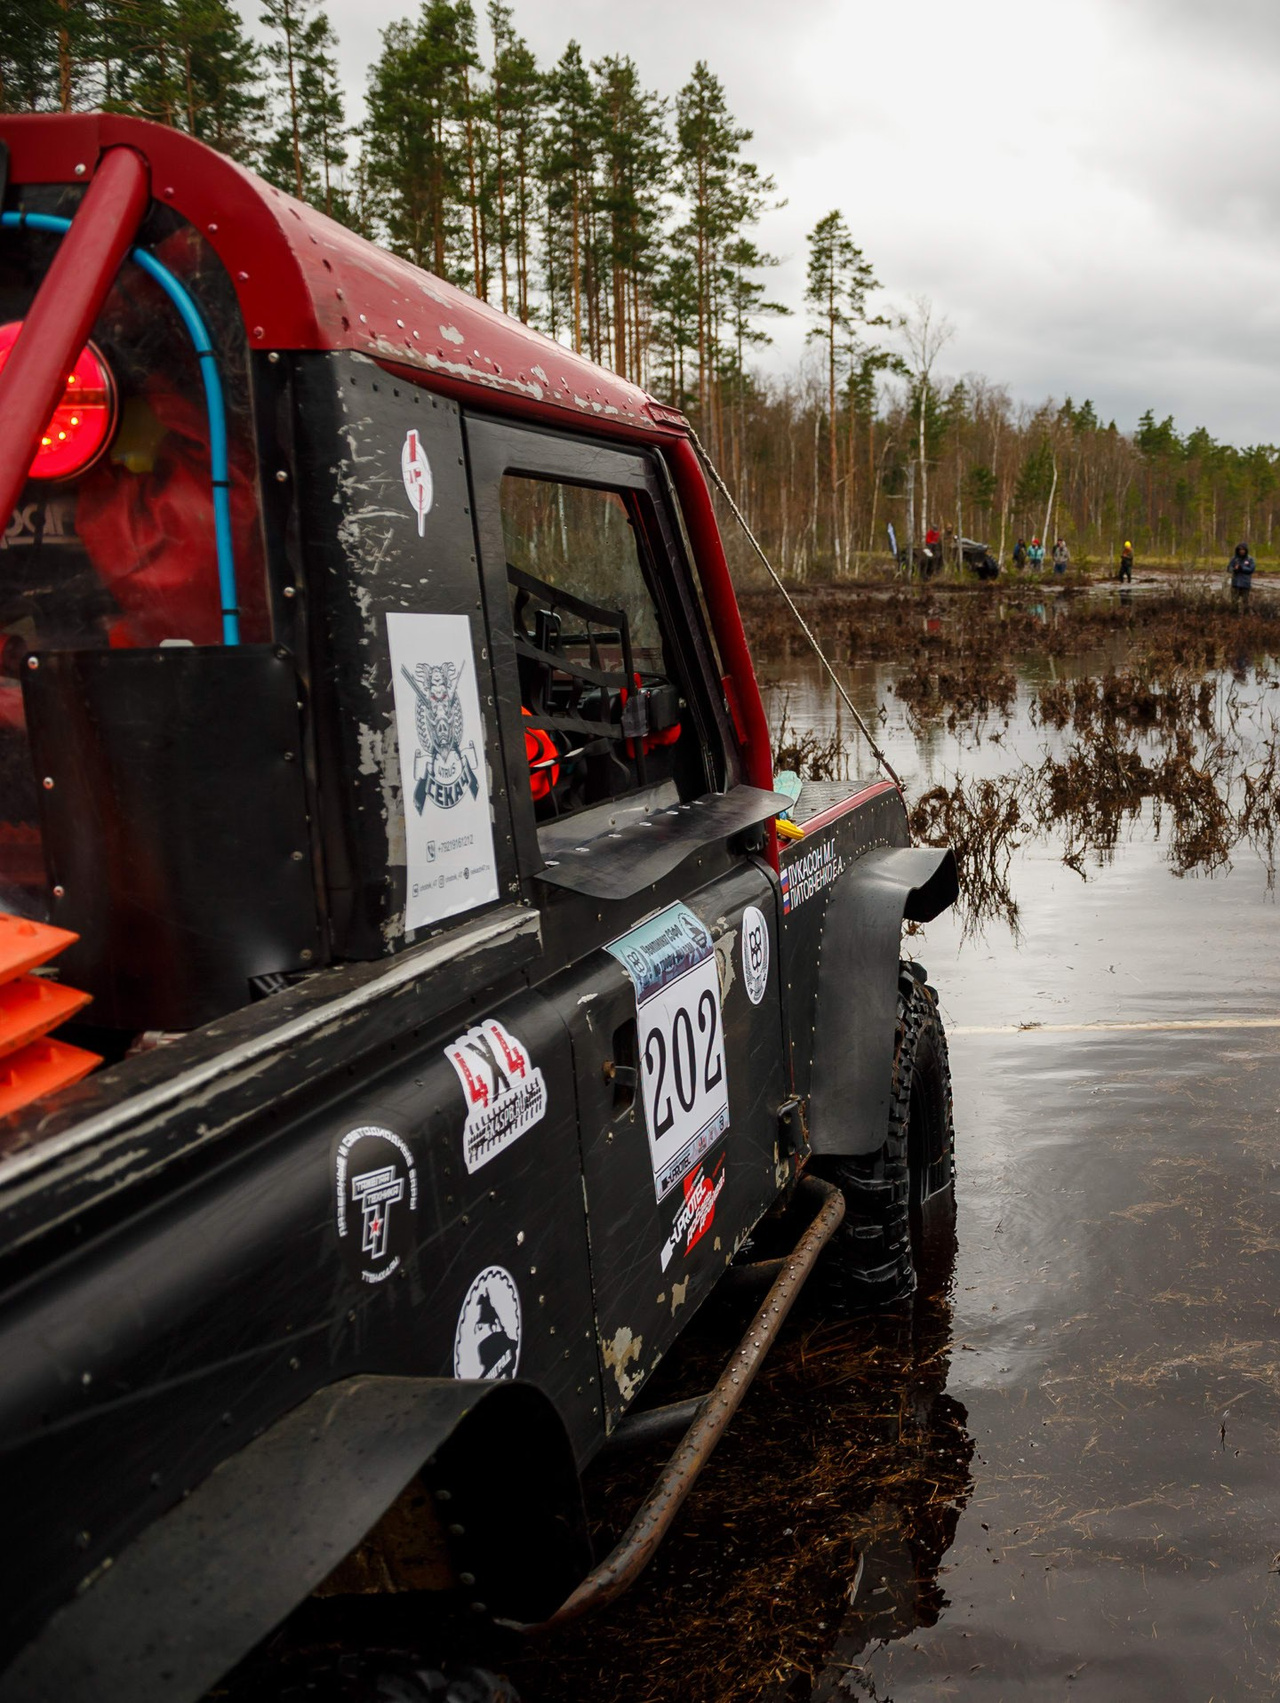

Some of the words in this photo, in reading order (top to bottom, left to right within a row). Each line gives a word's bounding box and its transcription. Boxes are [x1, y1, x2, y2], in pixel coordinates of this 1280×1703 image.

[427, 769, 470, 807] СЕКАЧ
[788, 846, 822, 889] ЛУКАСОН
[453, 1026, 525, 1108] 4X4
[645, 989, 722, 1141] 202
[664, 1175, 706, 1258] SUPROTEC
